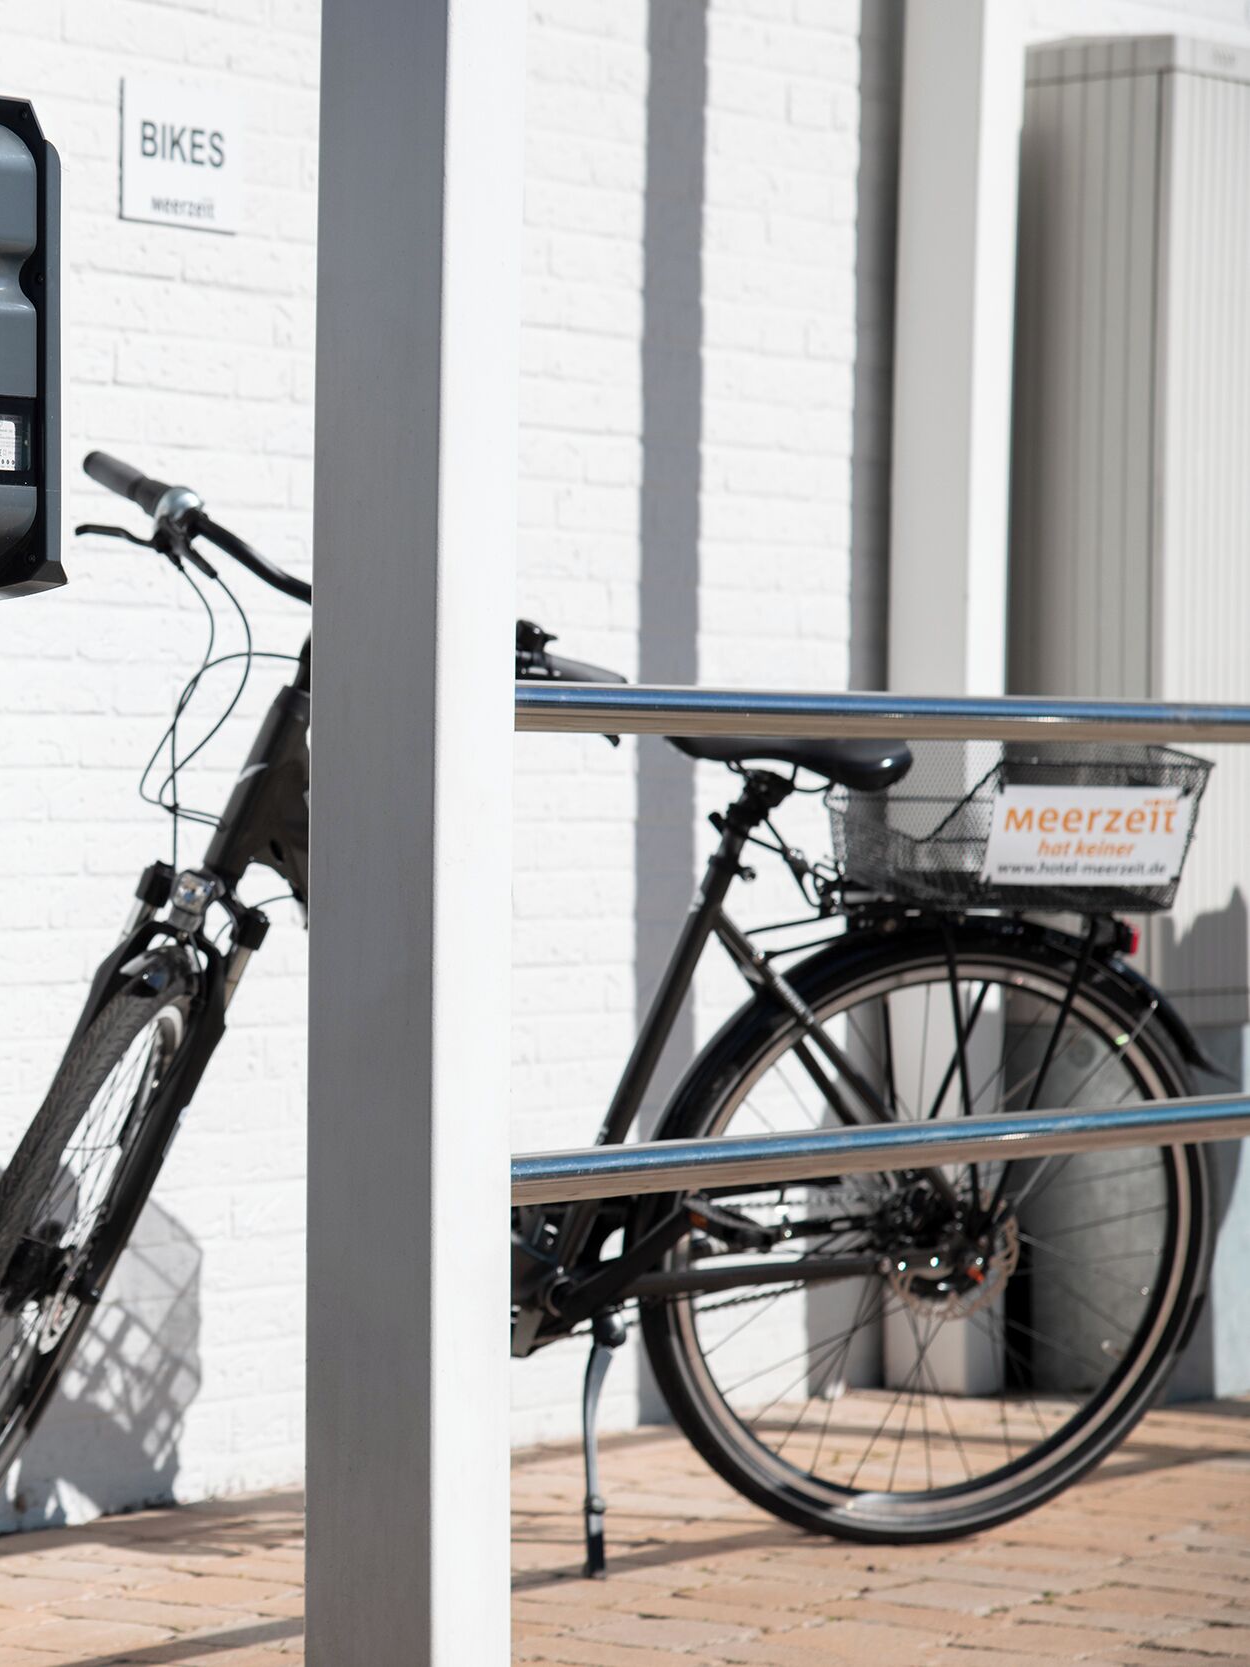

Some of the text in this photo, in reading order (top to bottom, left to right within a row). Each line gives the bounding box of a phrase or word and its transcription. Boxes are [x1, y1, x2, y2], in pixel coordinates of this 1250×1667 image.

[141, 120, 225, 168] BIKES
[1003, 806, 1178, 834] Meerzeit
[1037, 837, 1136, 858] hat keiner
